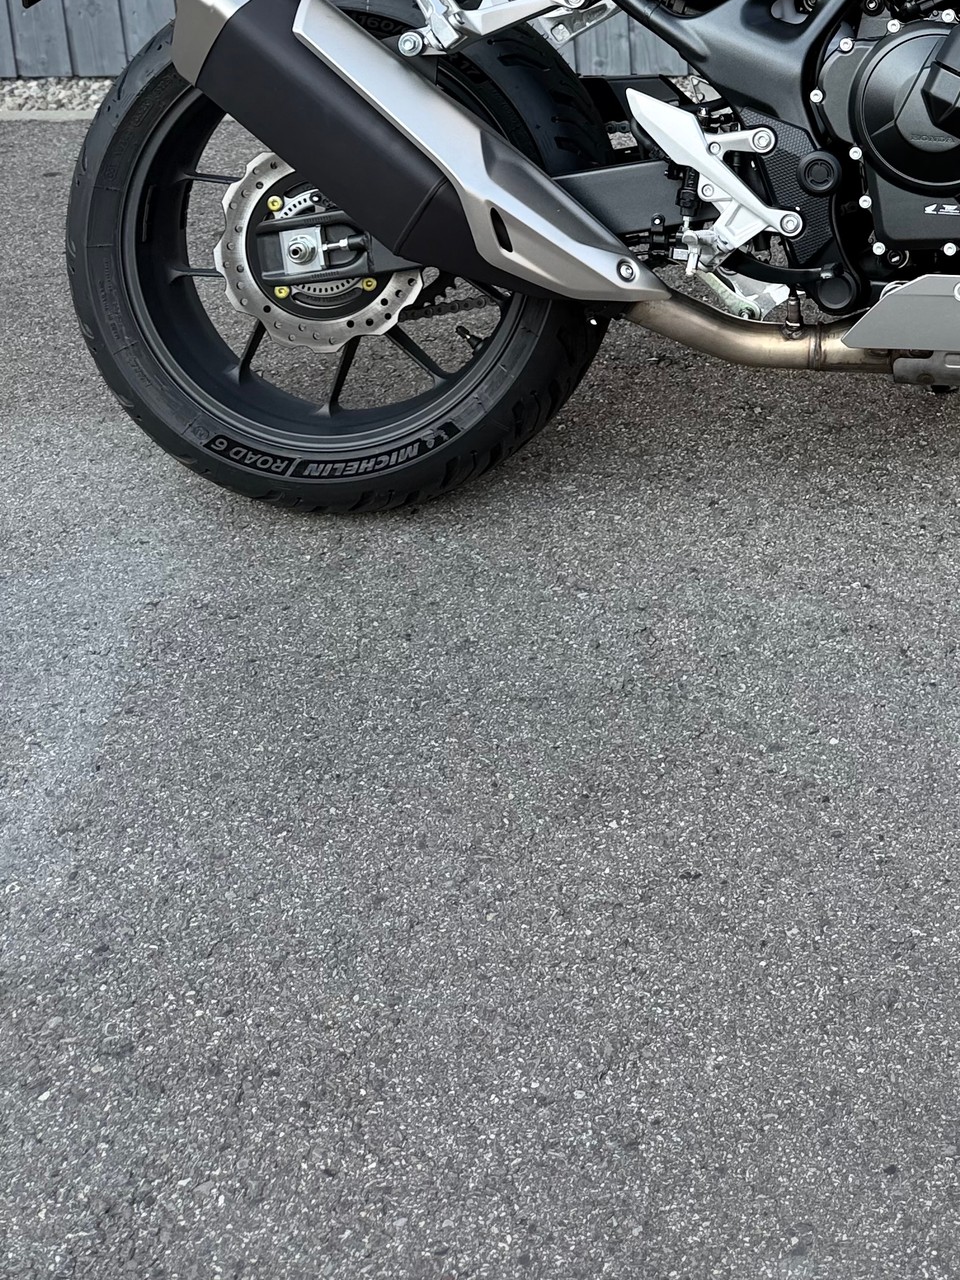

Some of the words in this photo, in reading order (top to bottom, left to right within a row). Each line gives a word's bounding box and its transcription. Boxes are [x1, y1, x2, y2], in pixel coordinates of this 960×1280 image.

[911, 134, 955, 143] HONDA
[211, 437, 227, 451] 6
[229, 446, 289, 473] ROAD
[304, 441, 420, 477] MICHELIN
